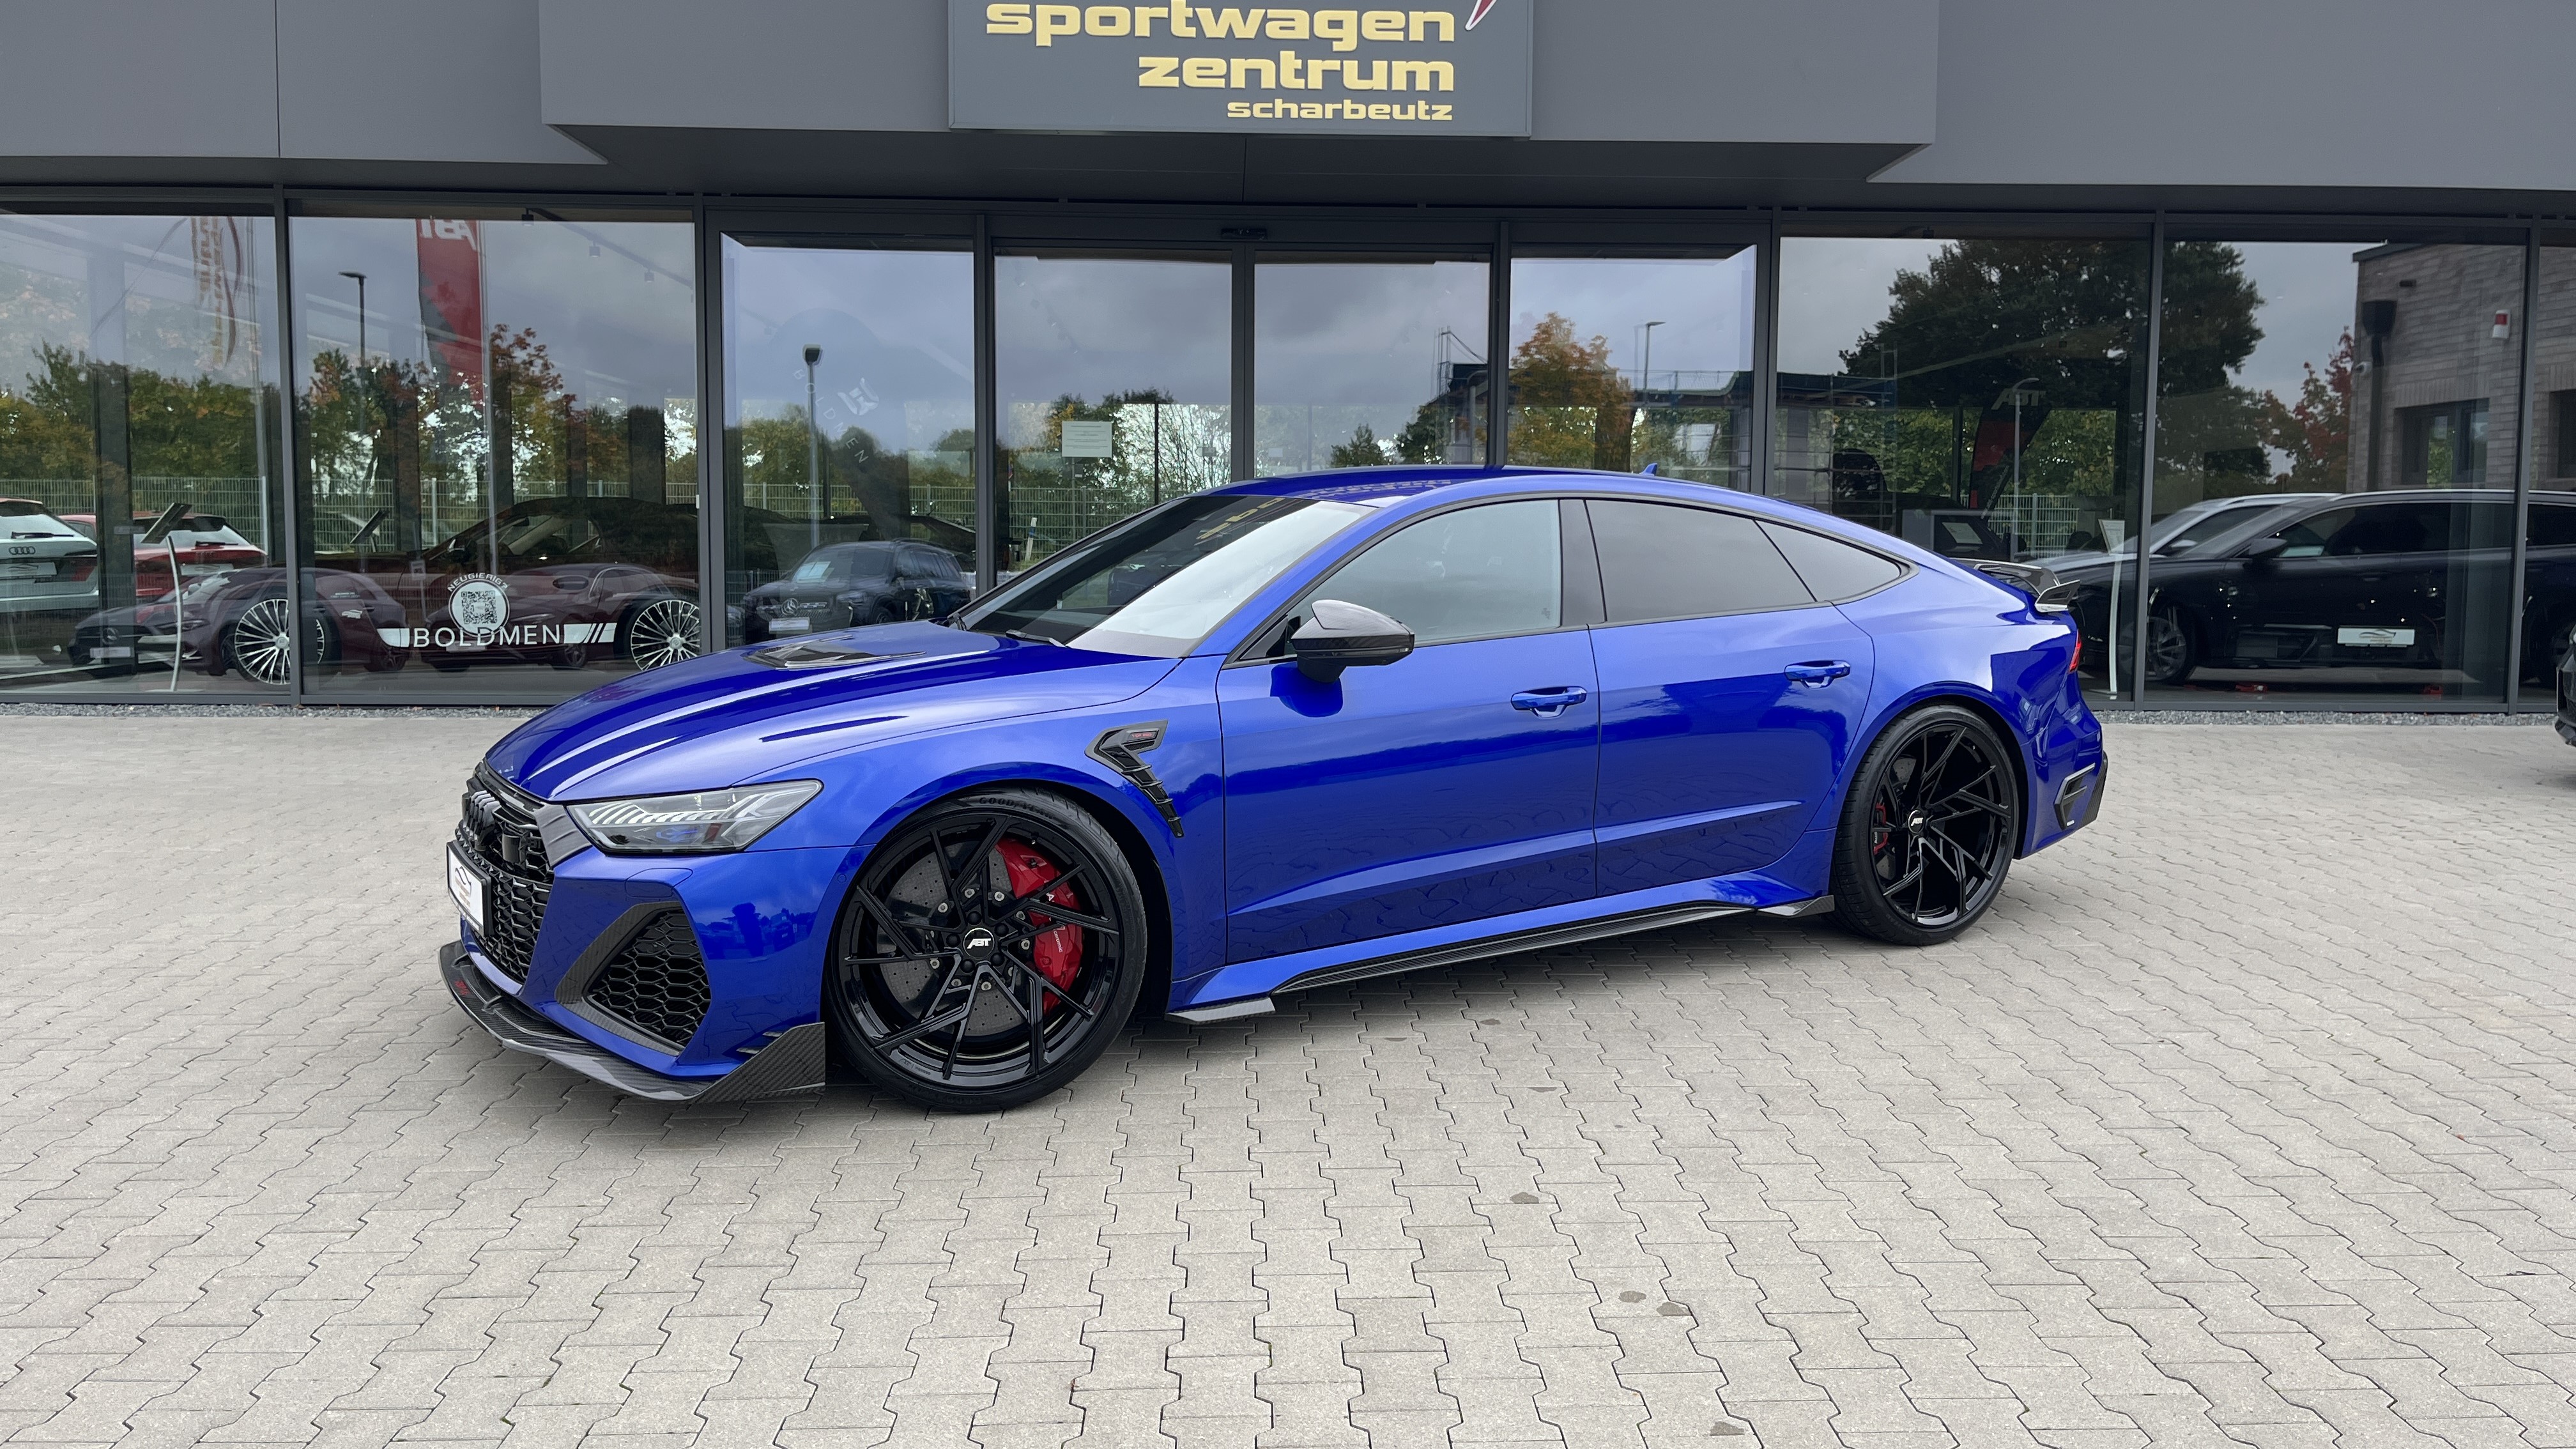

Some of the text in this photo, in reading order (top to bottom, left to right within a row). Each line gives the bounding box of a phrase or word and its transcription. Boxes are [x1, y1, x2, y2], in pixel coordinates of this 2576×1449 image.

[986, 0, 1455, 51] sportwagen
[1138, 51, 1454, 91] zentrum
[1227, 99, 1453, 121] scharbeutz
[447, 572, 509, 592] NEUGIERIG?
[413, 624, 560, 648] BOLDMEN
[967, 938, 992, 949] ABT
